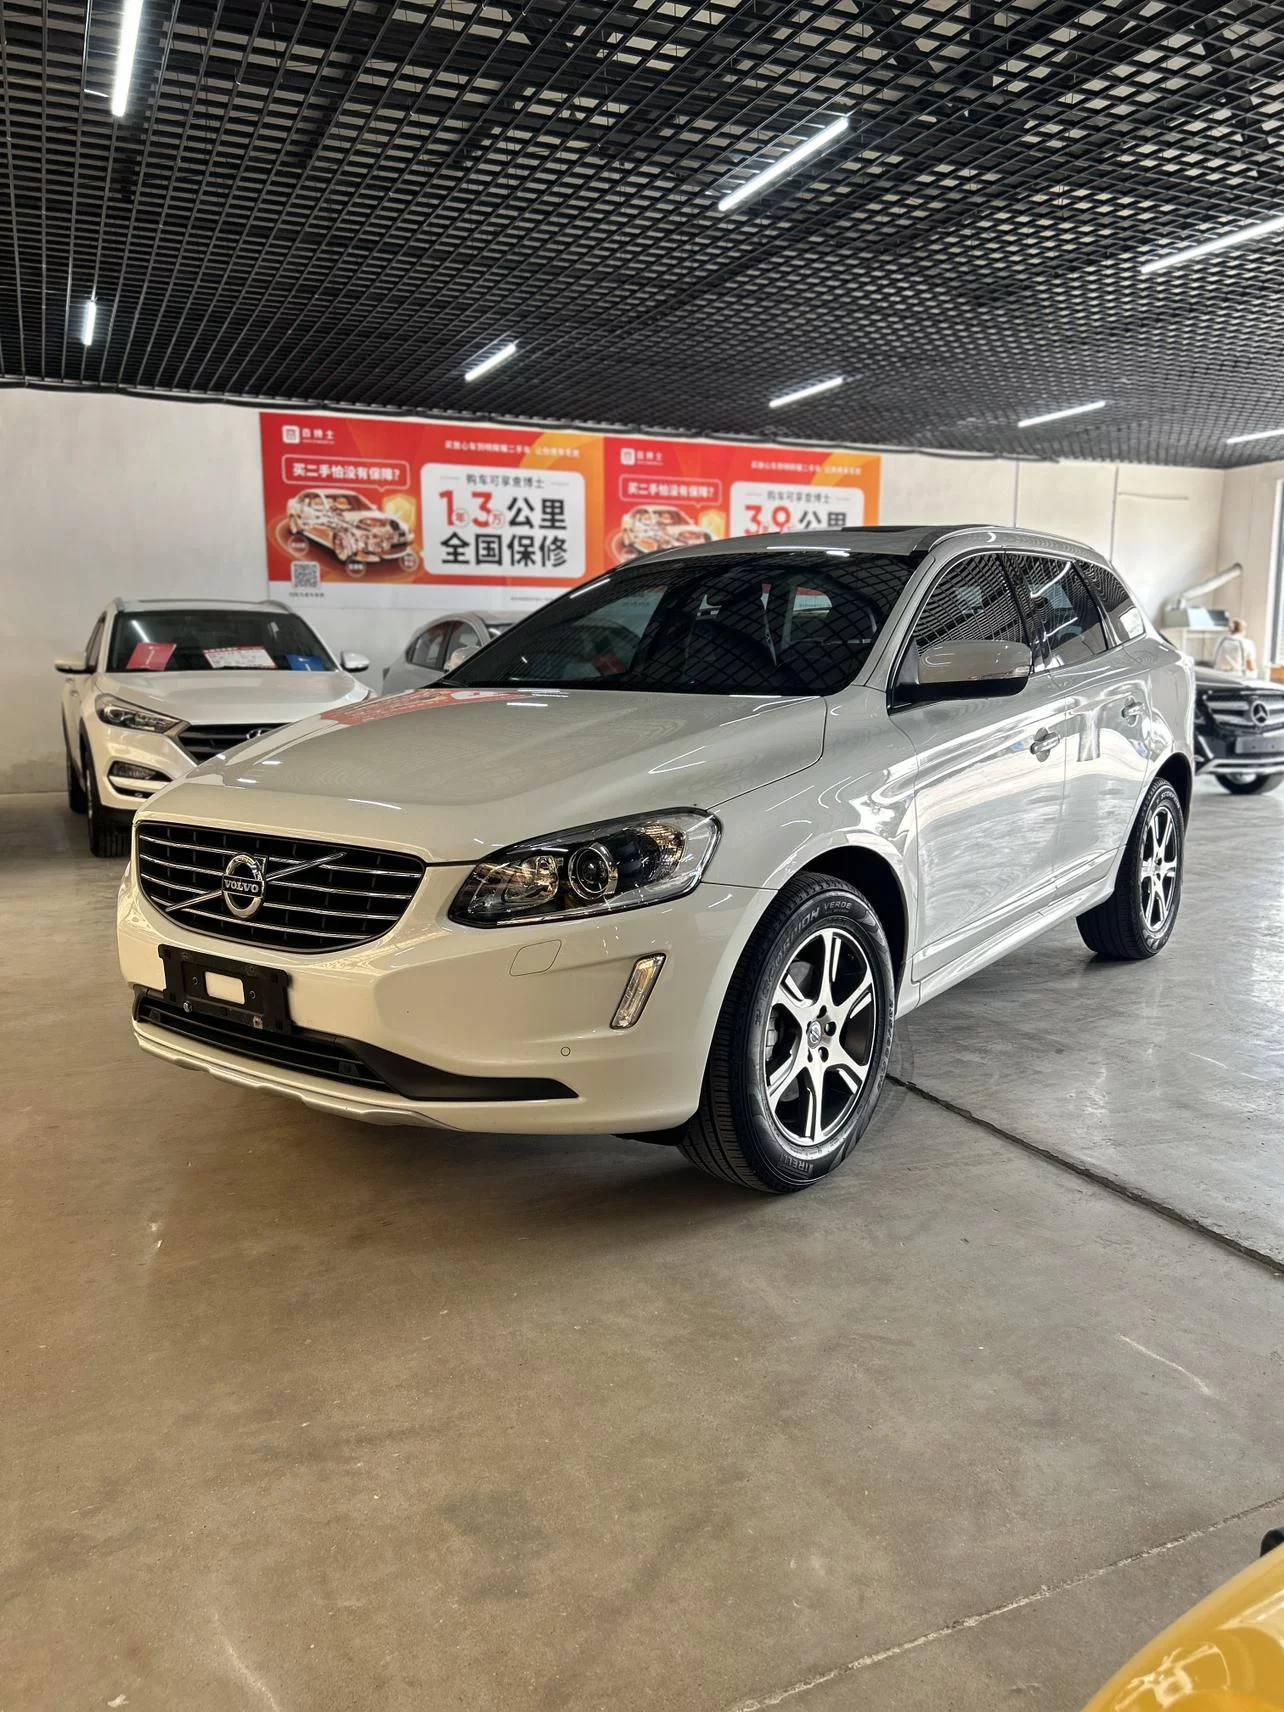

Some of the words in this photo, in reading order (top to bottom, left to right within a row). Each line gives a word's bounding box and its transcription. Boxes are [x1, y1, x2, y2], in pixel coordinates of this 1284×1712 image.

[466, 474, 545, 489] 购车可享查博士
[440, 531, 568, 568] 全国保修
[223, 879, 259, 893] VOLVO
[824, 900, 853, 912] VERDE
